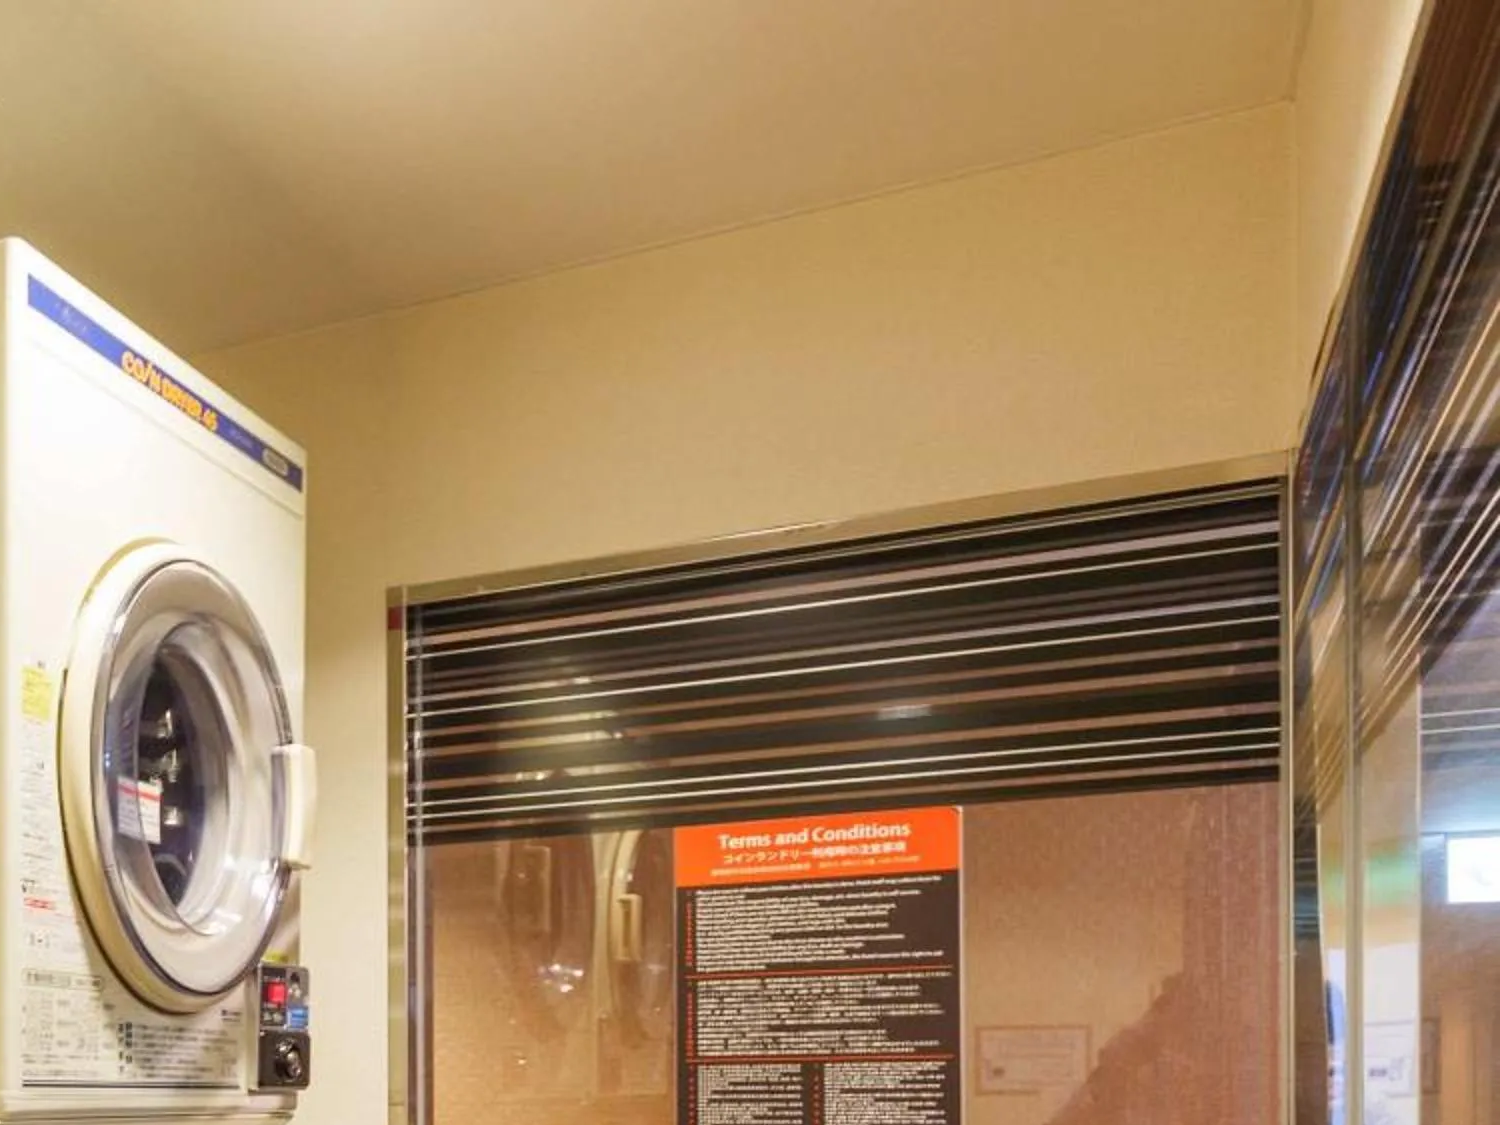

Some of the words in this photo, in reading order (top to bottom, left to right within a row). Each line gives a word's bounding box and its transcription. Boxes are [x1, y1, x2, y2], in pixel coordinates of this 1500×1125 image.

[718, 833, 773, 850] Terms
[775, 828, 809, 845] and
[811, 823, 912, 843] Conditions
